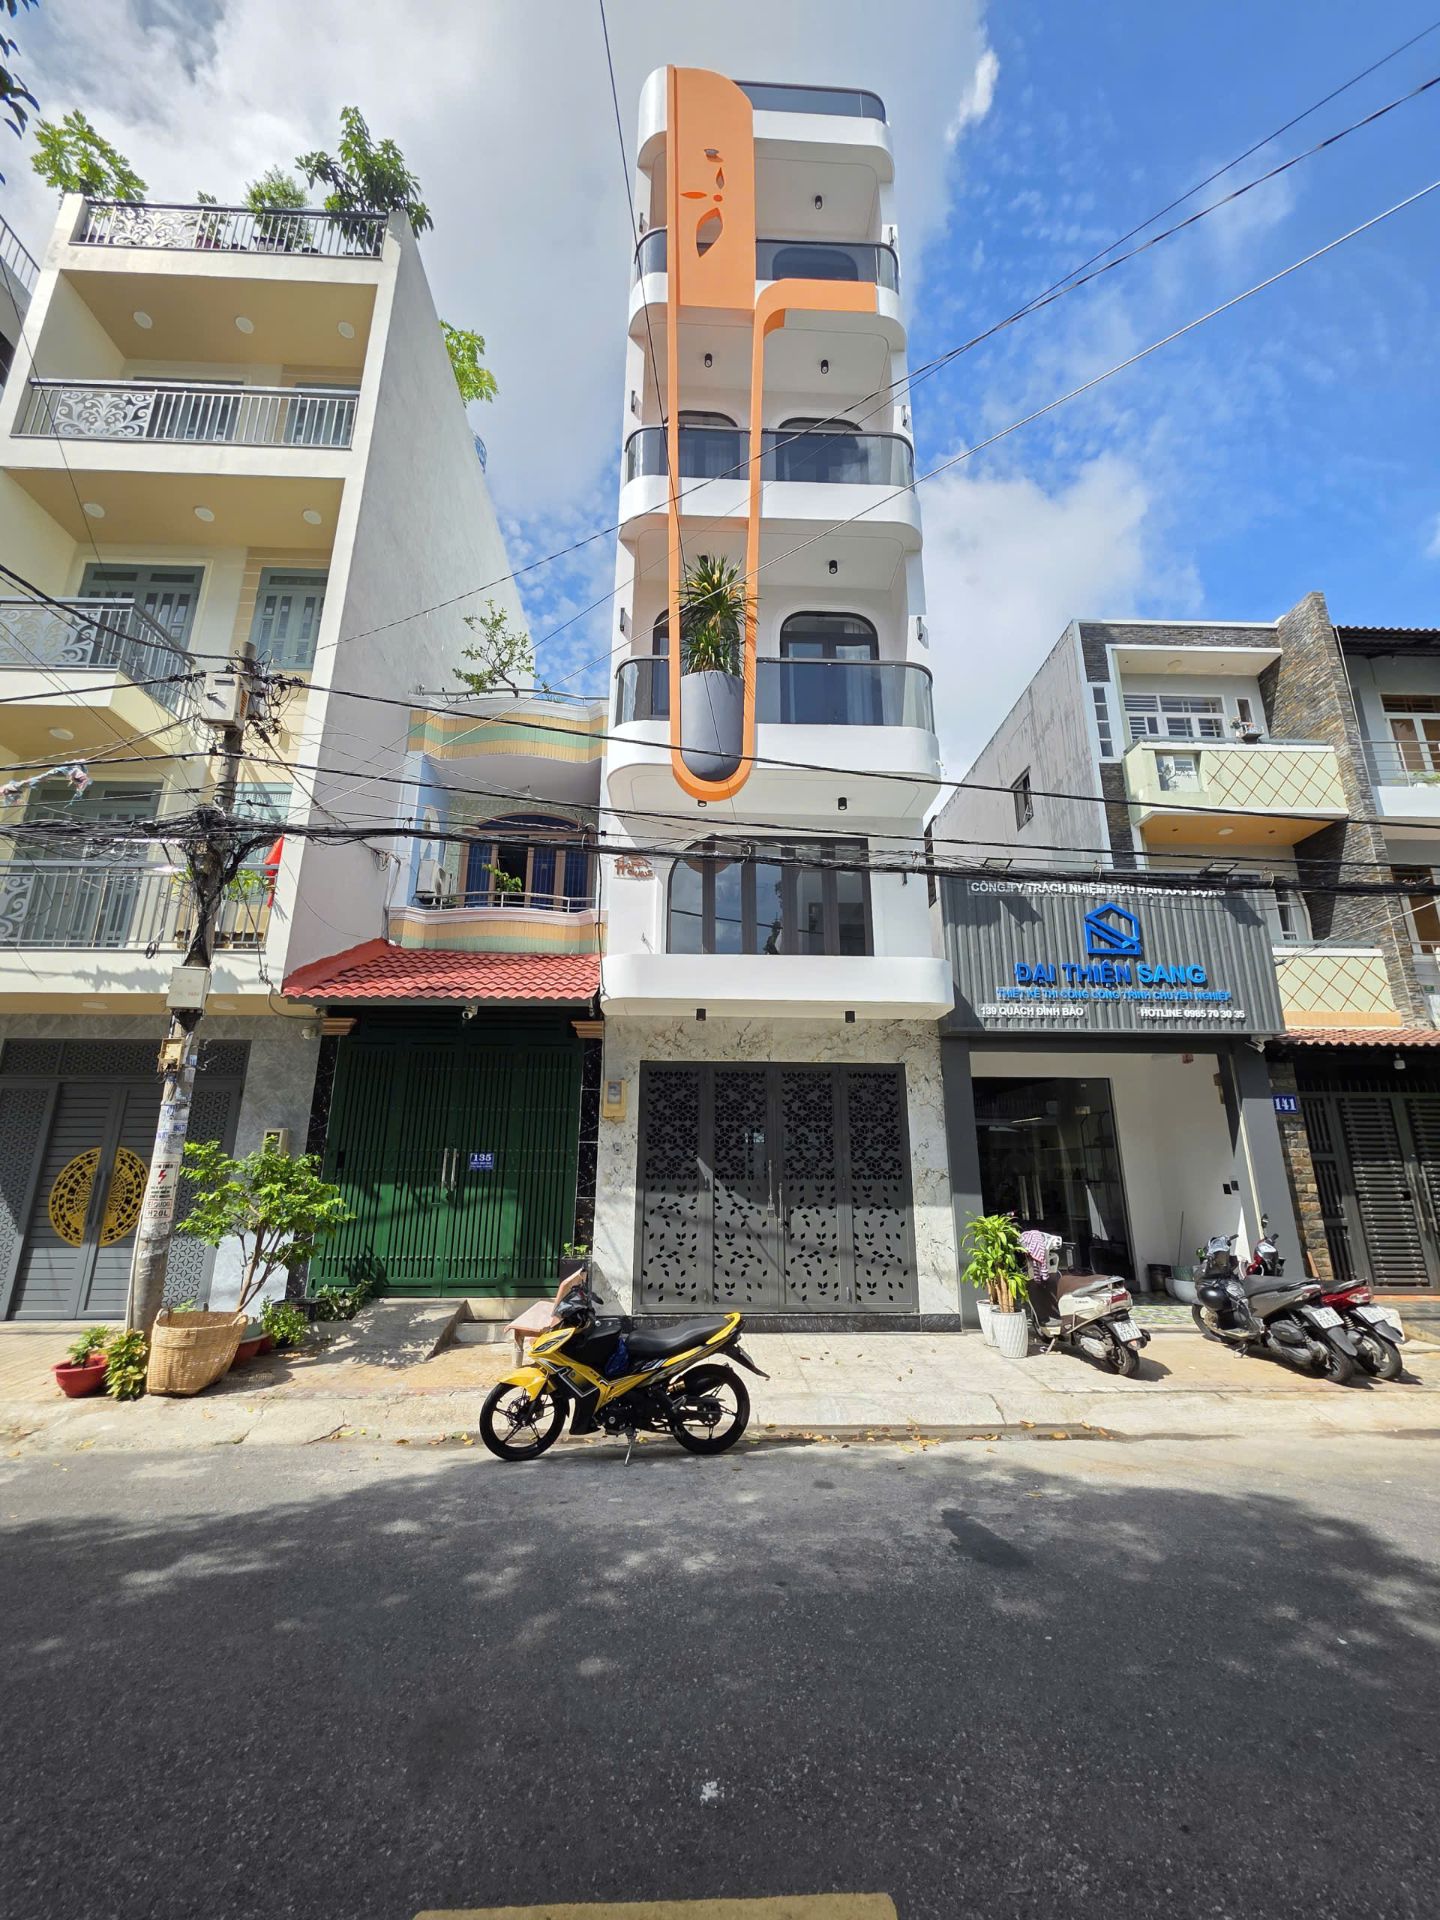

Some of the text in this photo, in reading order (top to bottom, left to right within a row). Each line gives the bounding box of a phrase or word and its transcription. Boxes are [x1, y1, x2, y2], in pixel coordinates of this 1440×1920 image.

[970, 881, 1006, 893] CÔNG
[1009, 882, 1024, 893] TY
[1026, 881, 1067, 893] TRÁCH
[1014, 959, 1206, 987] ĐẠI THIỆN SANG
[980, 1006, 997, 1015] 139
[999, 1005, 1034, 1016] QUÁCH
[1036, 1005, 1060, 1016] ĐÌNH
[1140, 1008, 1183, 1018] HOTLINE
[1220, 1010, 1233, 1019] 30
[1275, 1097, 1297, 1111] 141
[473, 1153, 492, 1162] 135
